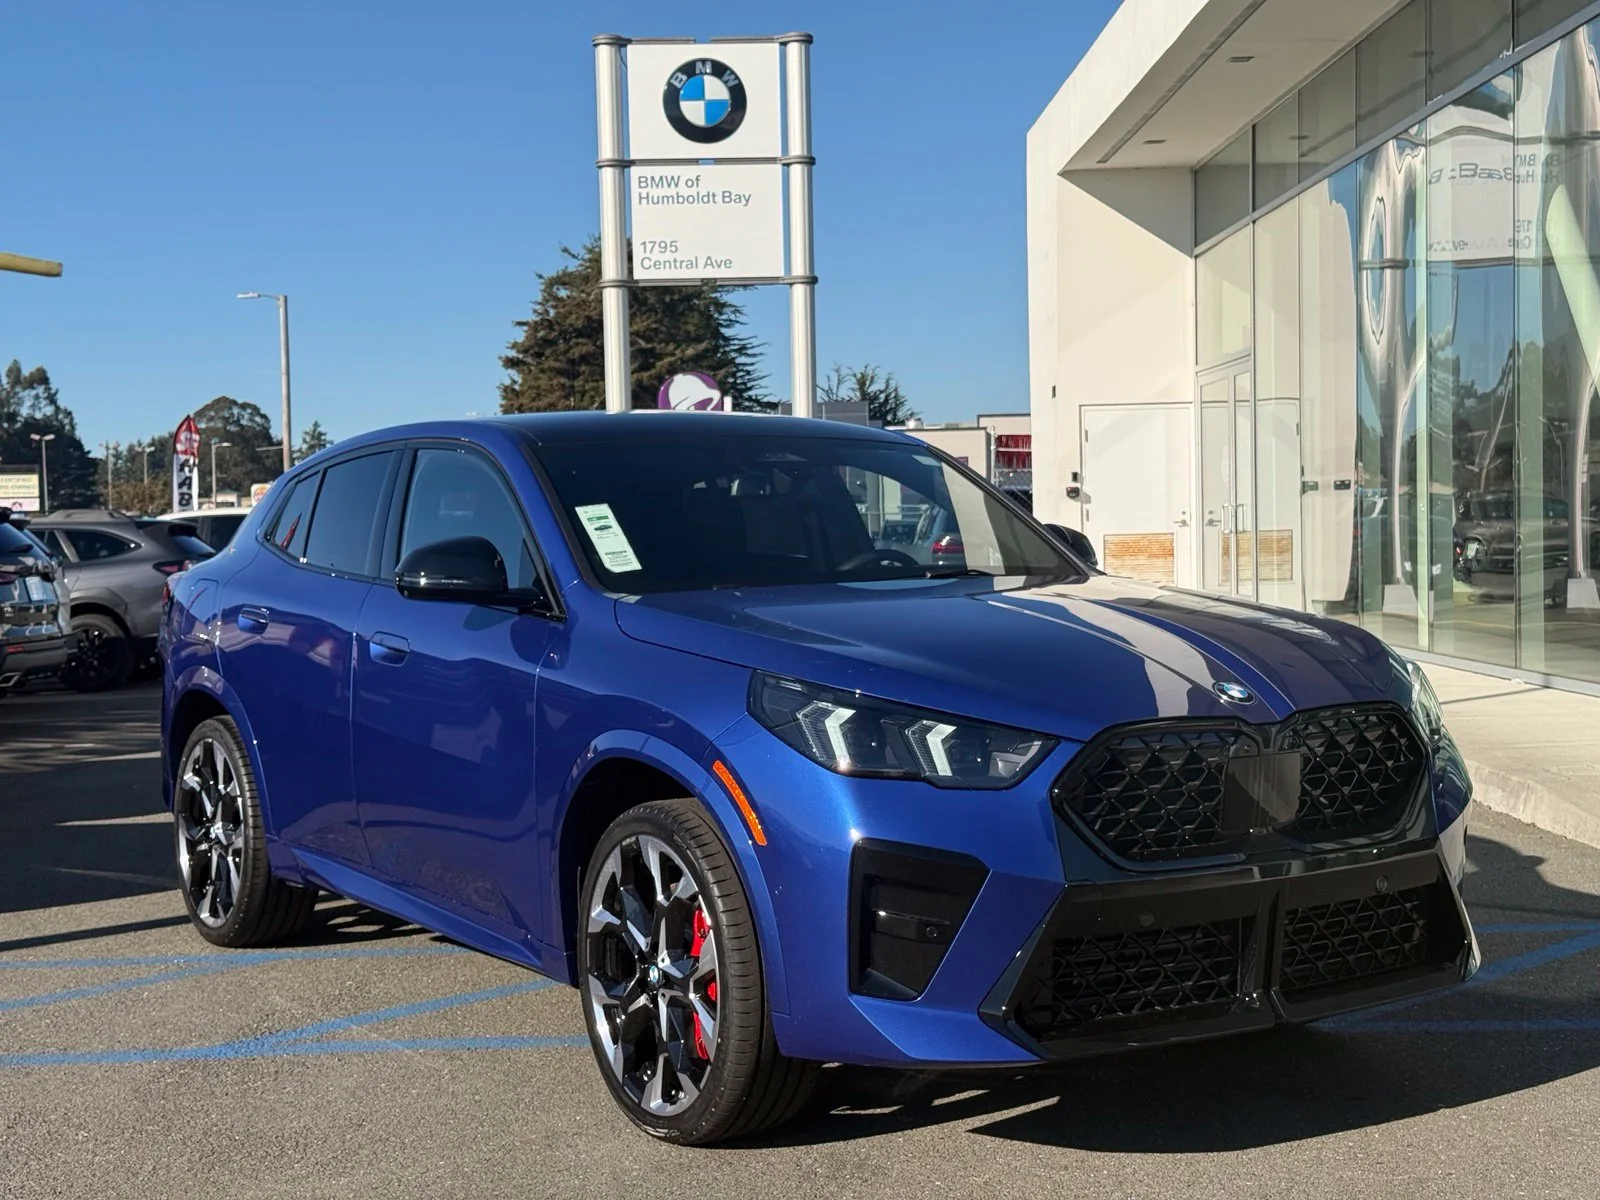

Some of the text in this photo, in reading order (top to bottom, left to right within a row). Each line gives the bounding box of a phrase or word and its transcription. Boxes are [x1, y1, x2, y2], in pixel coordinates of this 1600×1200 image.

[669, 60, 740, 89] BMW
[638, 174, 701, 189] BMW of
[638, 190, 752, 207] Humboldt Bay
[640, 240, 679, 254] 1795
[640, 255, 733, 270] Central Ave
